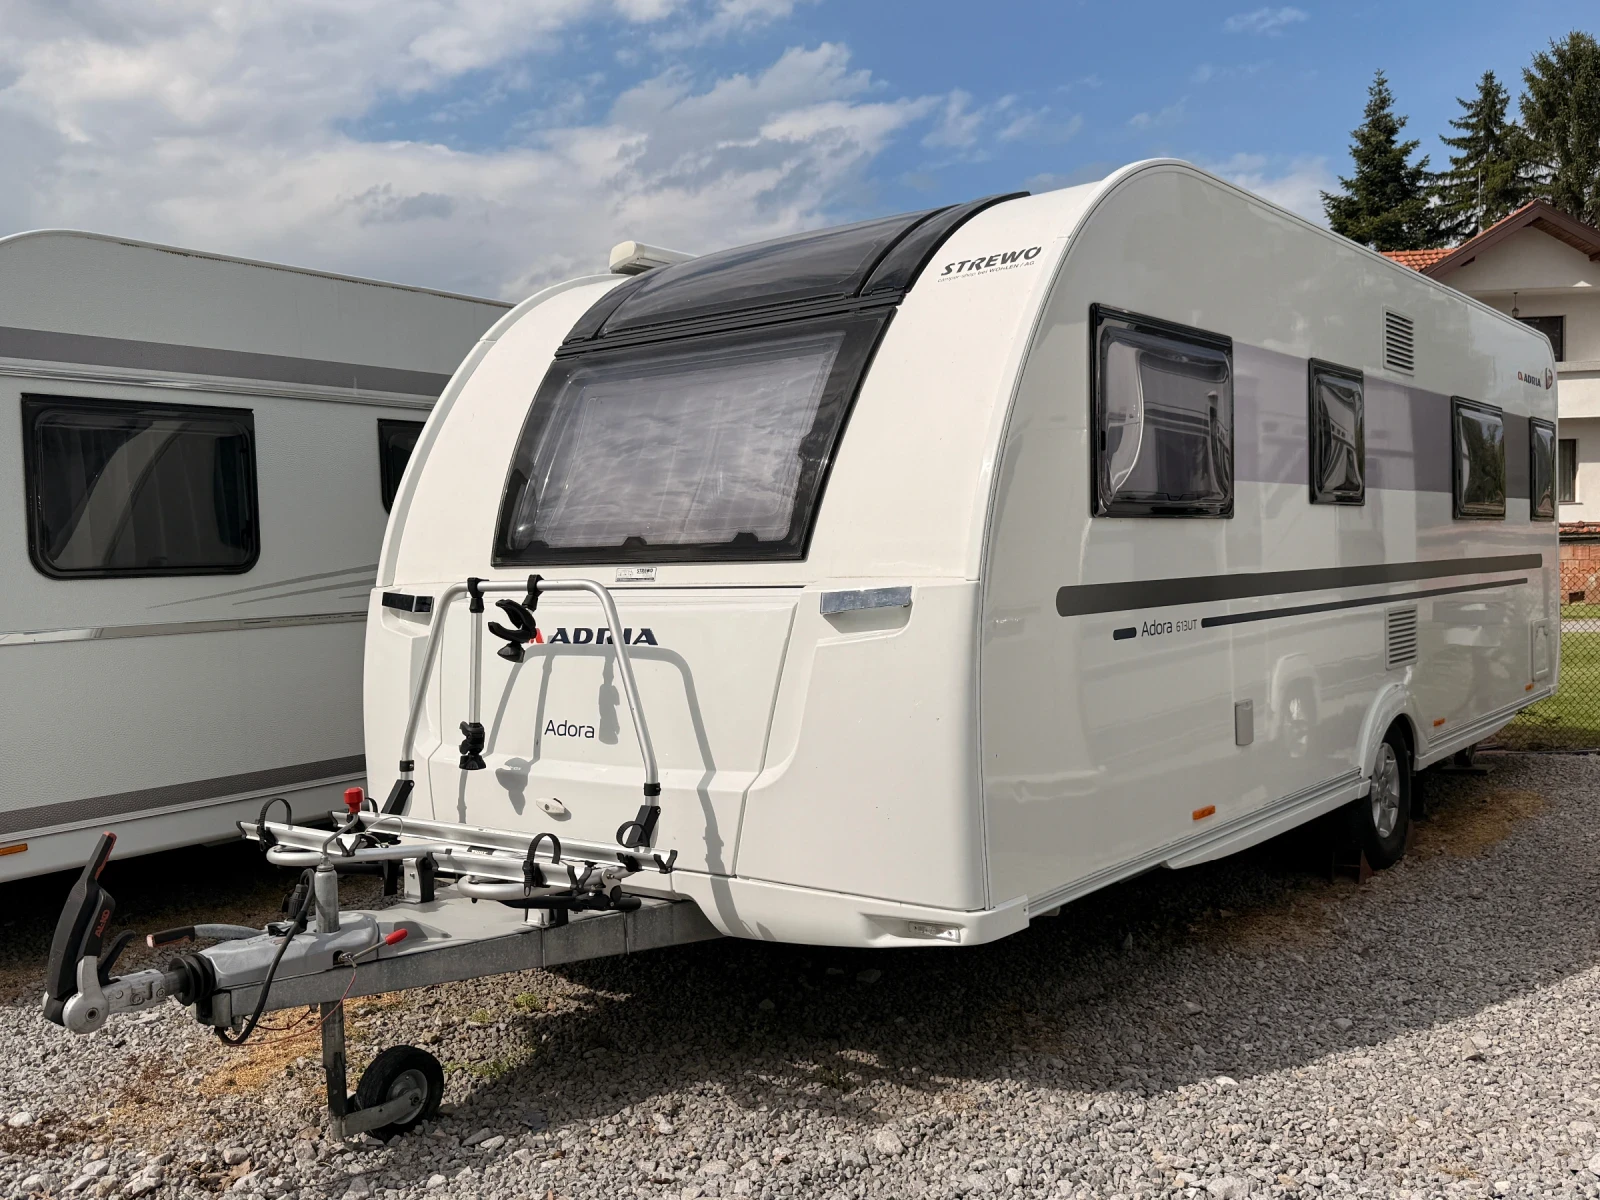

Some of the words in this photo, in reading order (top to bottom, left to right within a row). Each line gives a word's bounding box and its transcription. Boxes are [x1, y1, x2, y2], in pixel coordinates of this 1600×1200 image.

[941, 246, 1042, 276] STREWO
[1524, 373, 1541, 387] ADRIA
[549, 628, 658, 646] ADRIA
[1141, 619, 1173, 637] Adora
[1176, 619, 1198, 632] 613UT
[544, 719, 595, 738] Adora
